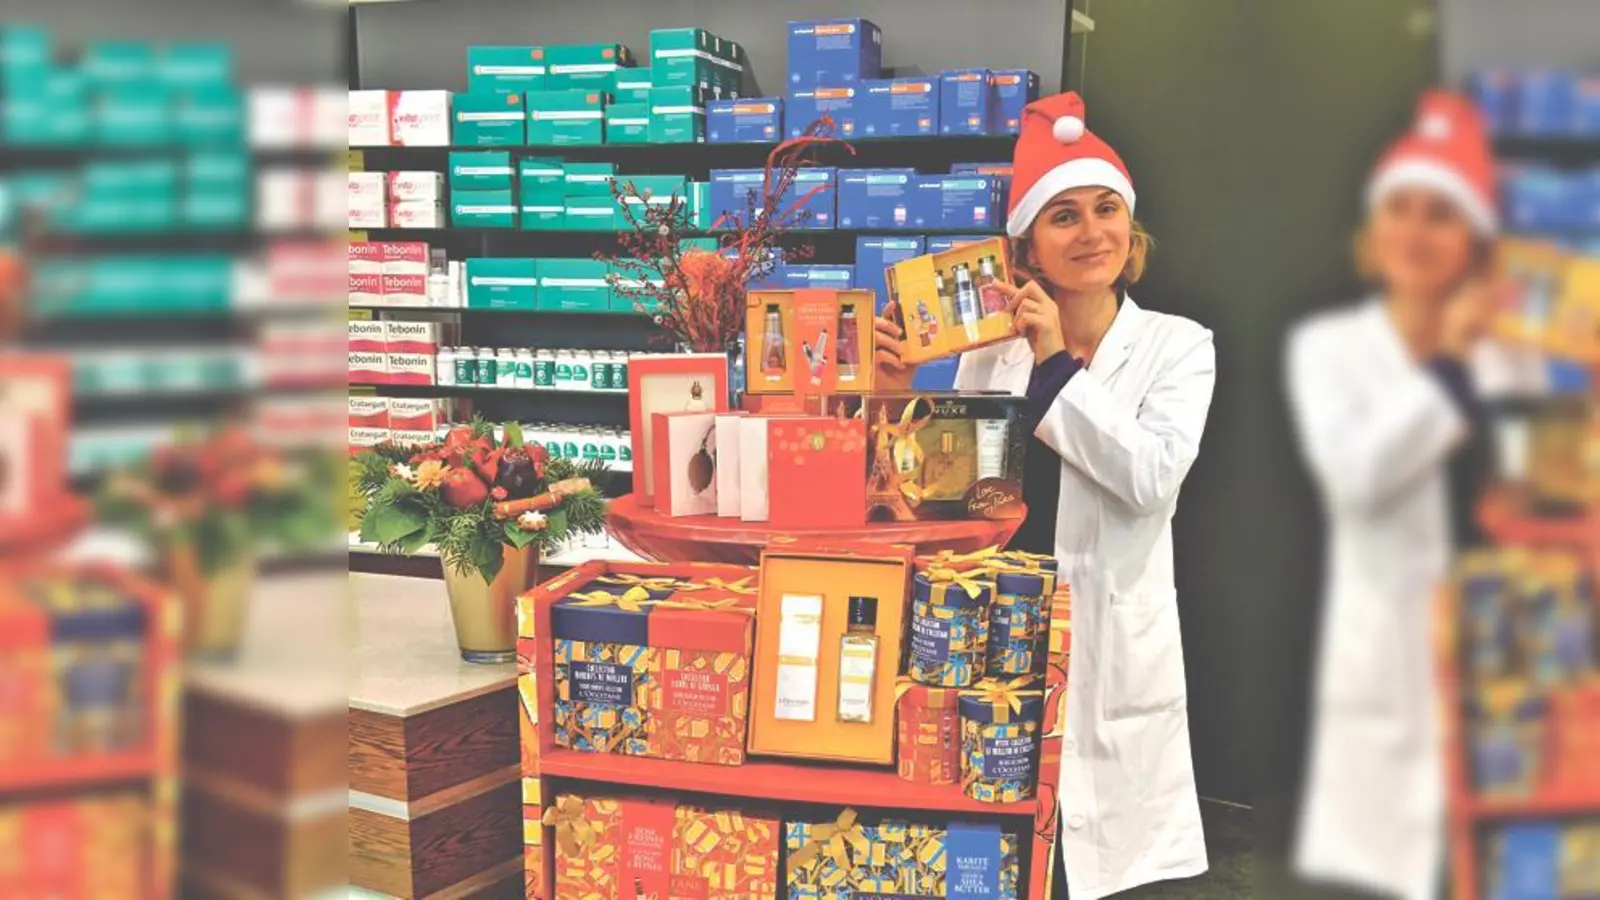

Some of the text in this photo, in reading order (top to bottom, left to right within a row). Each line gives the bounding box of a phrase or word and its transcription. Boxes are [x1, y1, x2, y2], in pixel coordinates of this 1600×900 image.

[383, 244, 422, 255] Tebonin
[383, 277, 422, 287] Tebonin
[388, 324, 426, 334] Tebonin
[389, 355, 427, 366] Tebonin
[954, 884, 990, 894] BUTTER
